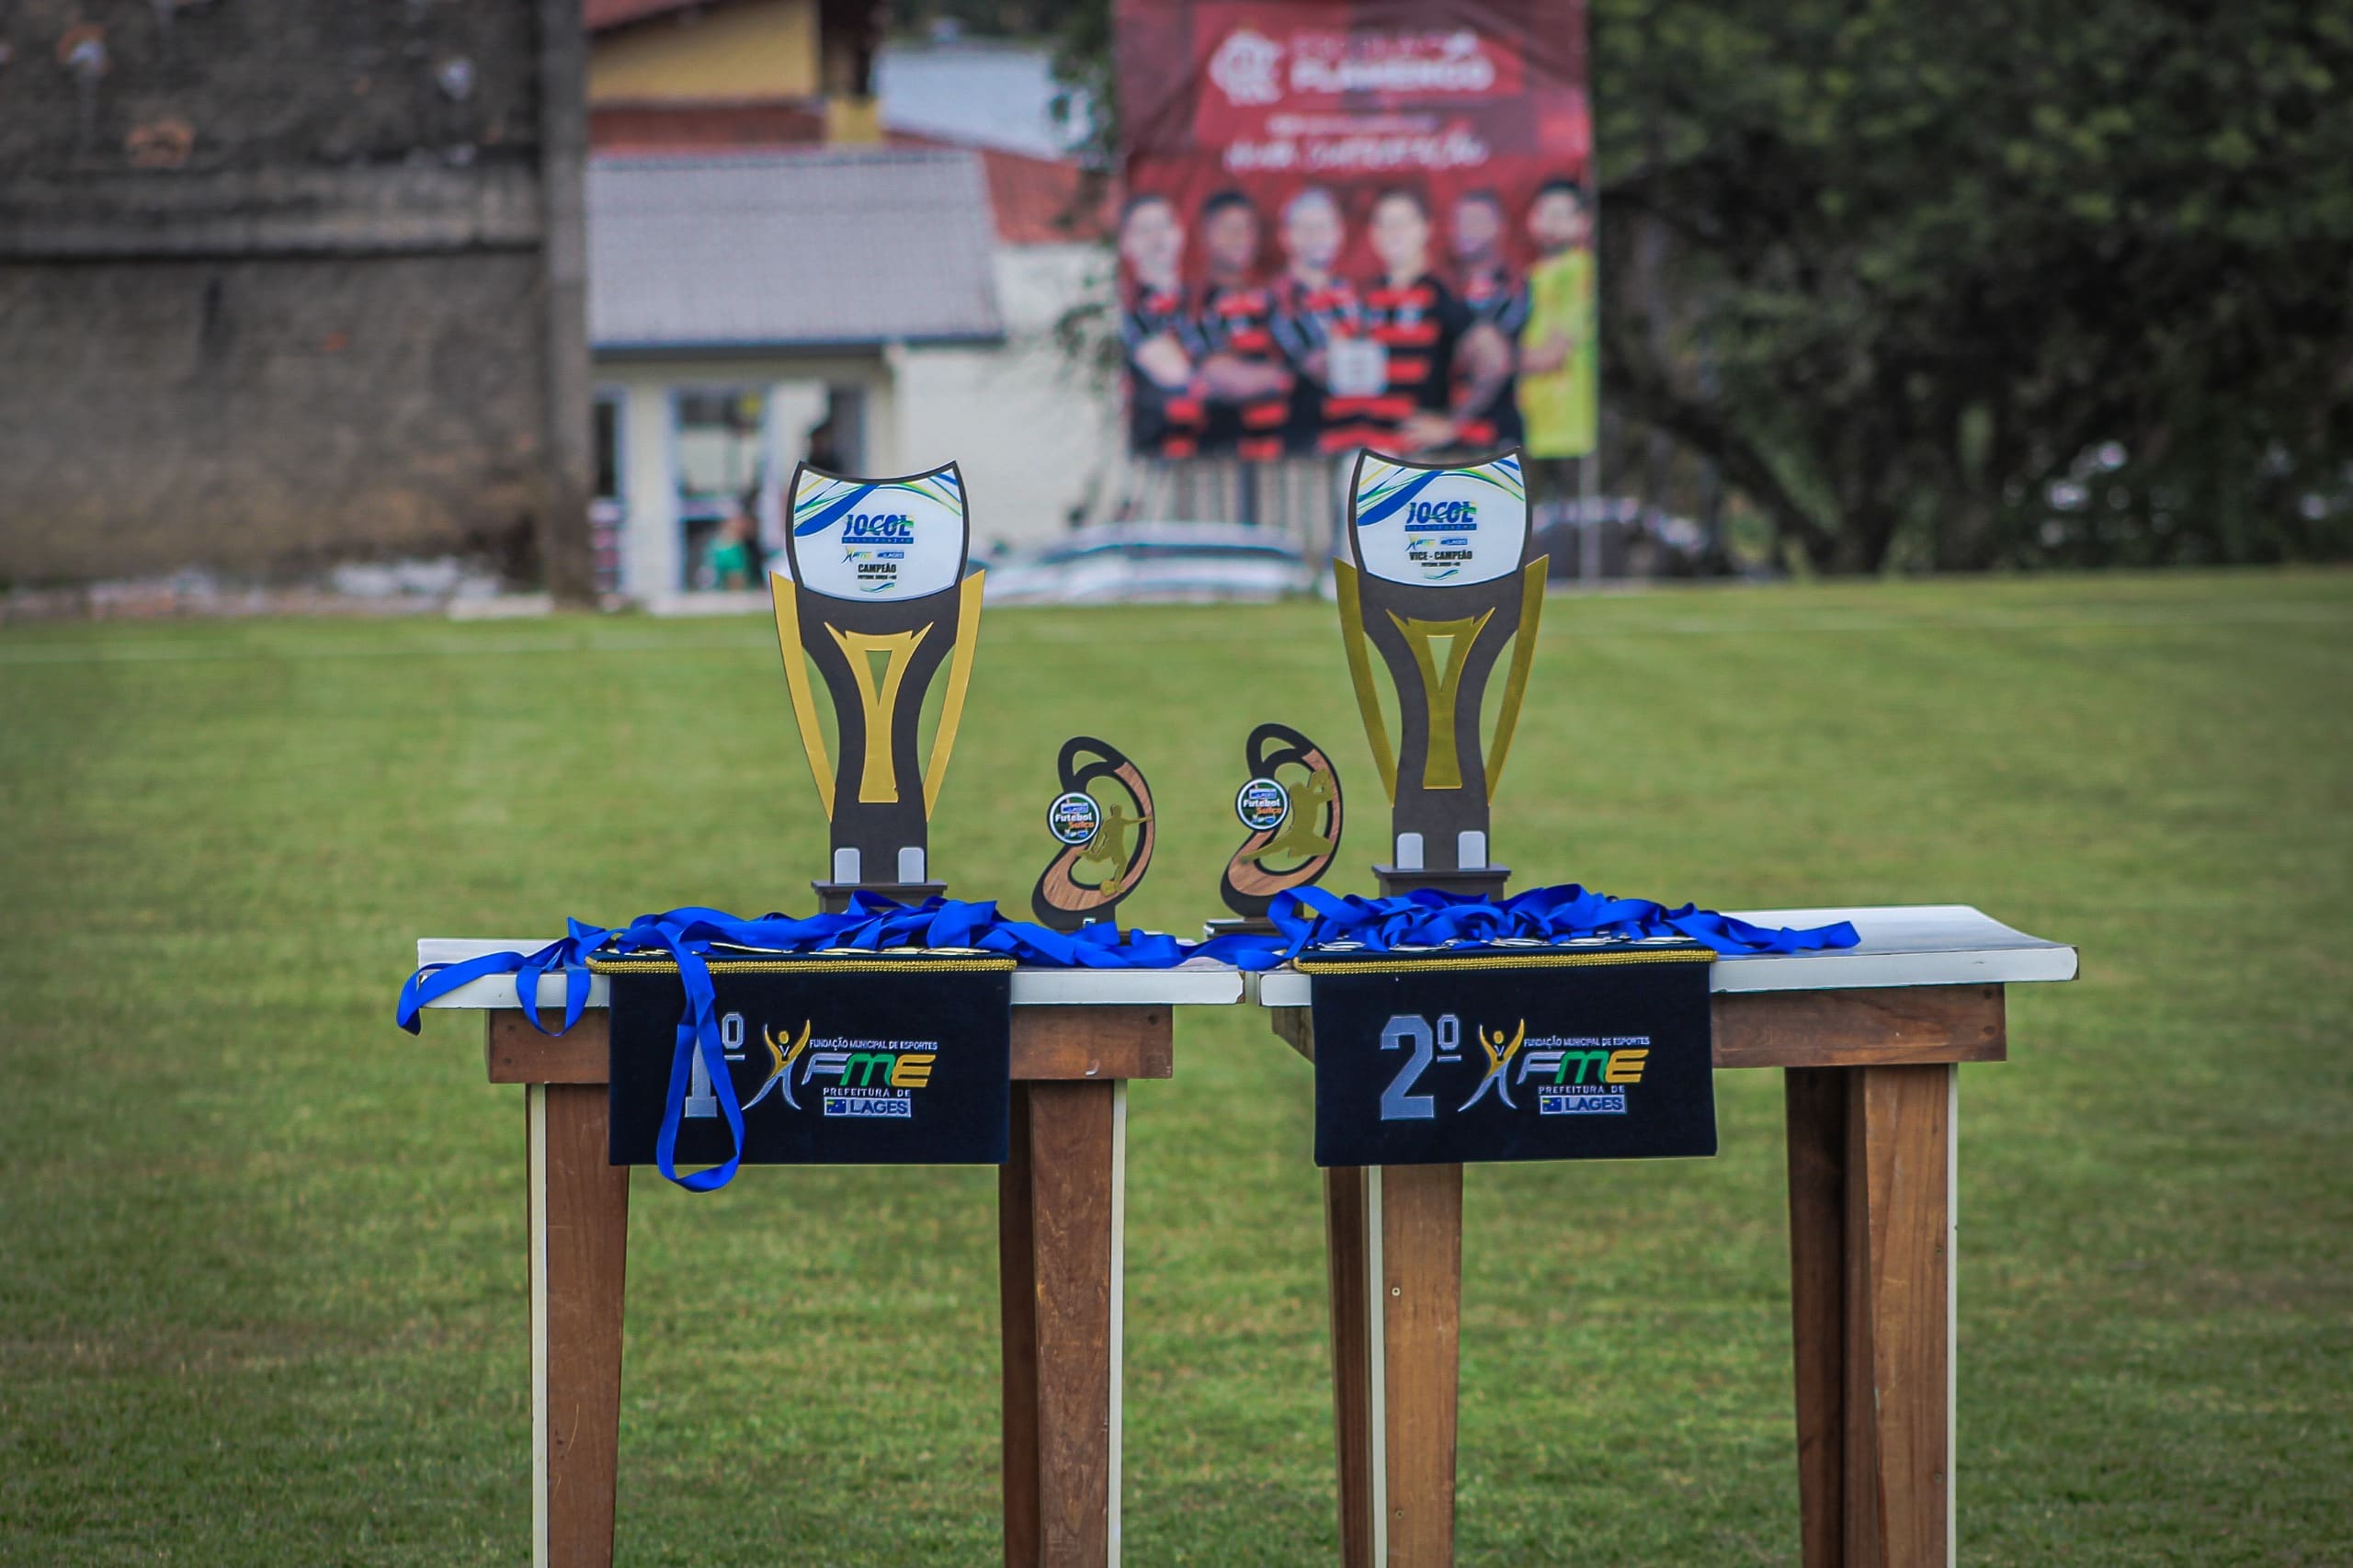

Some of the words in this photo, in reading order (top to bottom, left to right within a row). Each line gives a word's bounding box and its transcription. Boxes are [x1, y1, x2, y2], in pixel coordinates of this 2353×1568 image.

[1406, 501, 1477, 524] JOCOL
[843, 514, 914, 536] JOCOL
[1409, 551, 1427, 561] VICE
[1434, 550, 1472, 560] CAMPEÃO
[858, 562, 897, 574] CAMPEÃO
[1244, 799, 1280, 808] Futebol
[1055, 812, 1092, 823] Futebol
[810, 1038, 848, 1051] FUNDAÇÃO
[849, 1040, 888, 1050] MUNICIPAL
[889, 1040, 899, 1050] DE
[900, 1040, 938, 1051] ESPORTES
[1523, 1035, 1563, 1050] FUNDAÇÃO
[1563, 1038, 1600, 1047] MUNICIPAL
[1601, 1037, 1612, 1047] DE
[1613, 1036, 1651, 1046] ESPORTES
[801, 1052, 936, 1087] FME
[1381, 1014, 1461, 1120] 2º
[1516, 1049, 1650, 1085] FME
[823, 1087, 890, 1097] PREFEITURA
[896, 1088, 911, 1097] DE
[1538, 1085, 1605, 1095] PREFEITURA
[1610, 1085, 1626, 1094] DE
[849, 1098, 909, 1114] LAGES
[1564, 1096, 1624, 1111] LAGES
